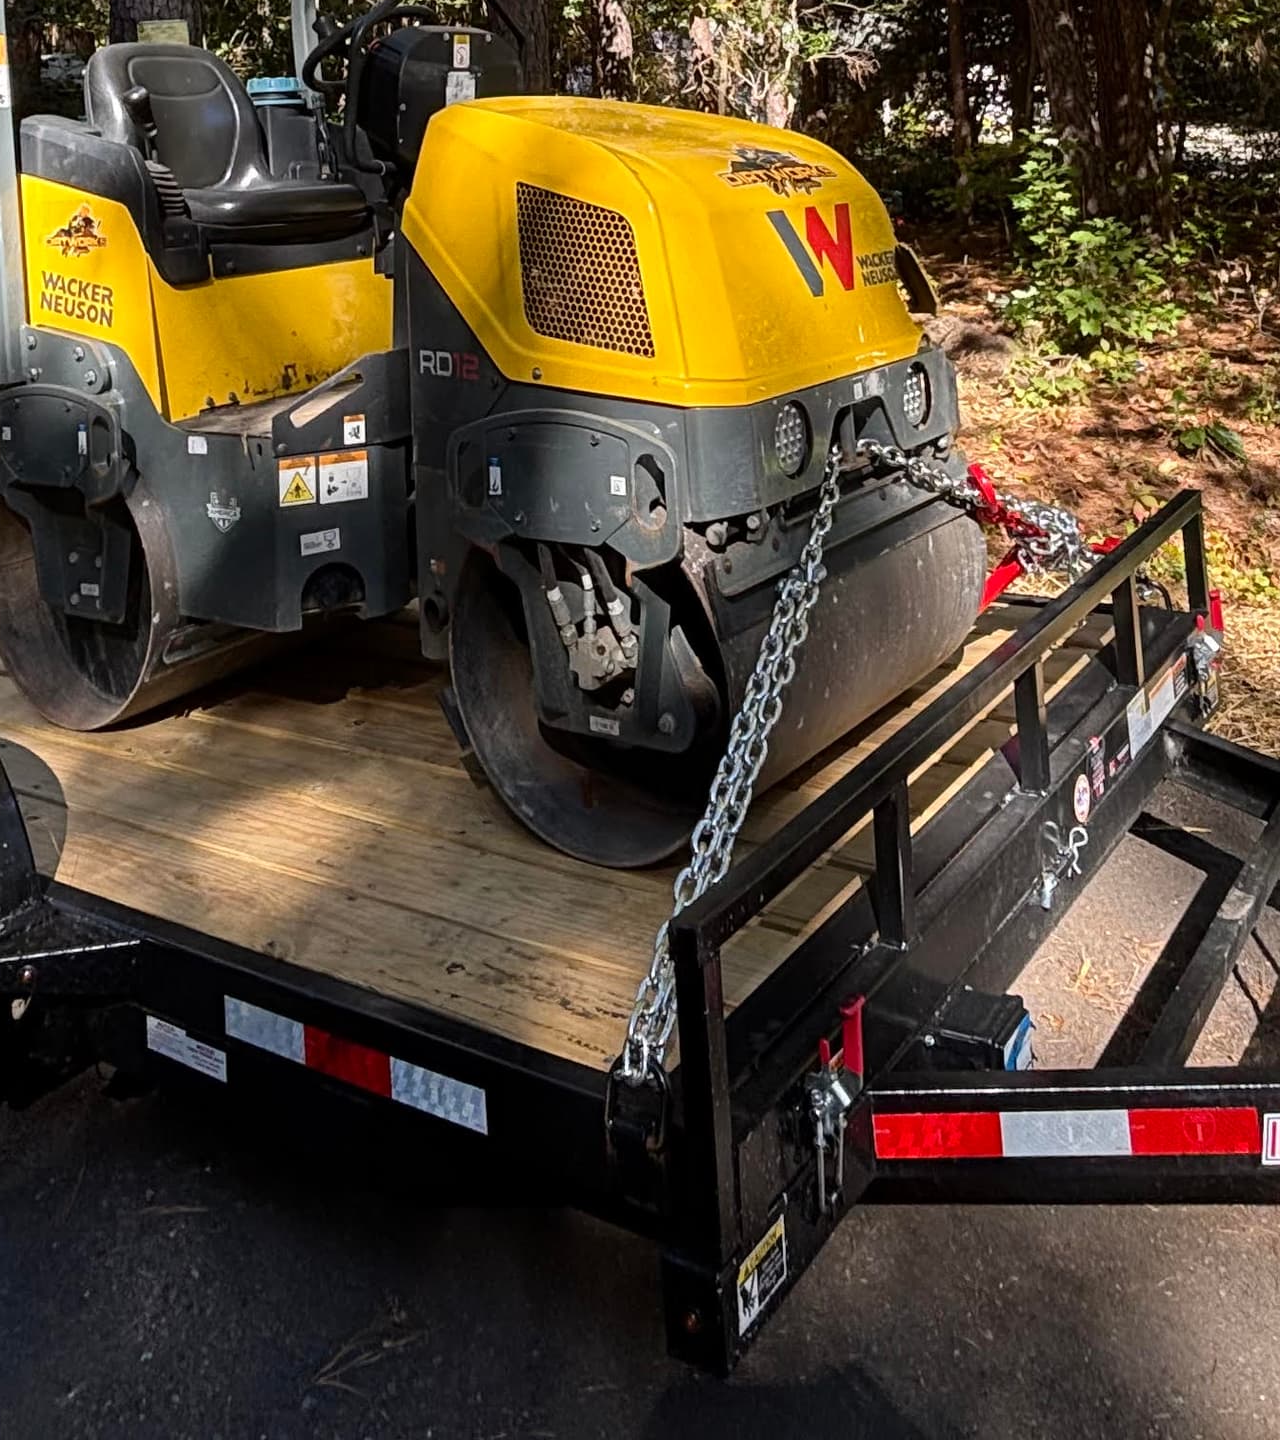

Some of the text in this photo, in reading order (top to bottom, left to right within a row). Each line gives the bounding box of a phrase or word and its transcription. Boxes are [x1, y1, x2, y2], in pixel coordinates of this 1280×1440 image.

[856, 250, 894, 270] WACKE
[41, 270, 114, 307] WACKER
[861, 266, 897, 287] NEUSO
[40, 291, 114, 328] NEUSON
[419, 349, 480, 380] RD12
